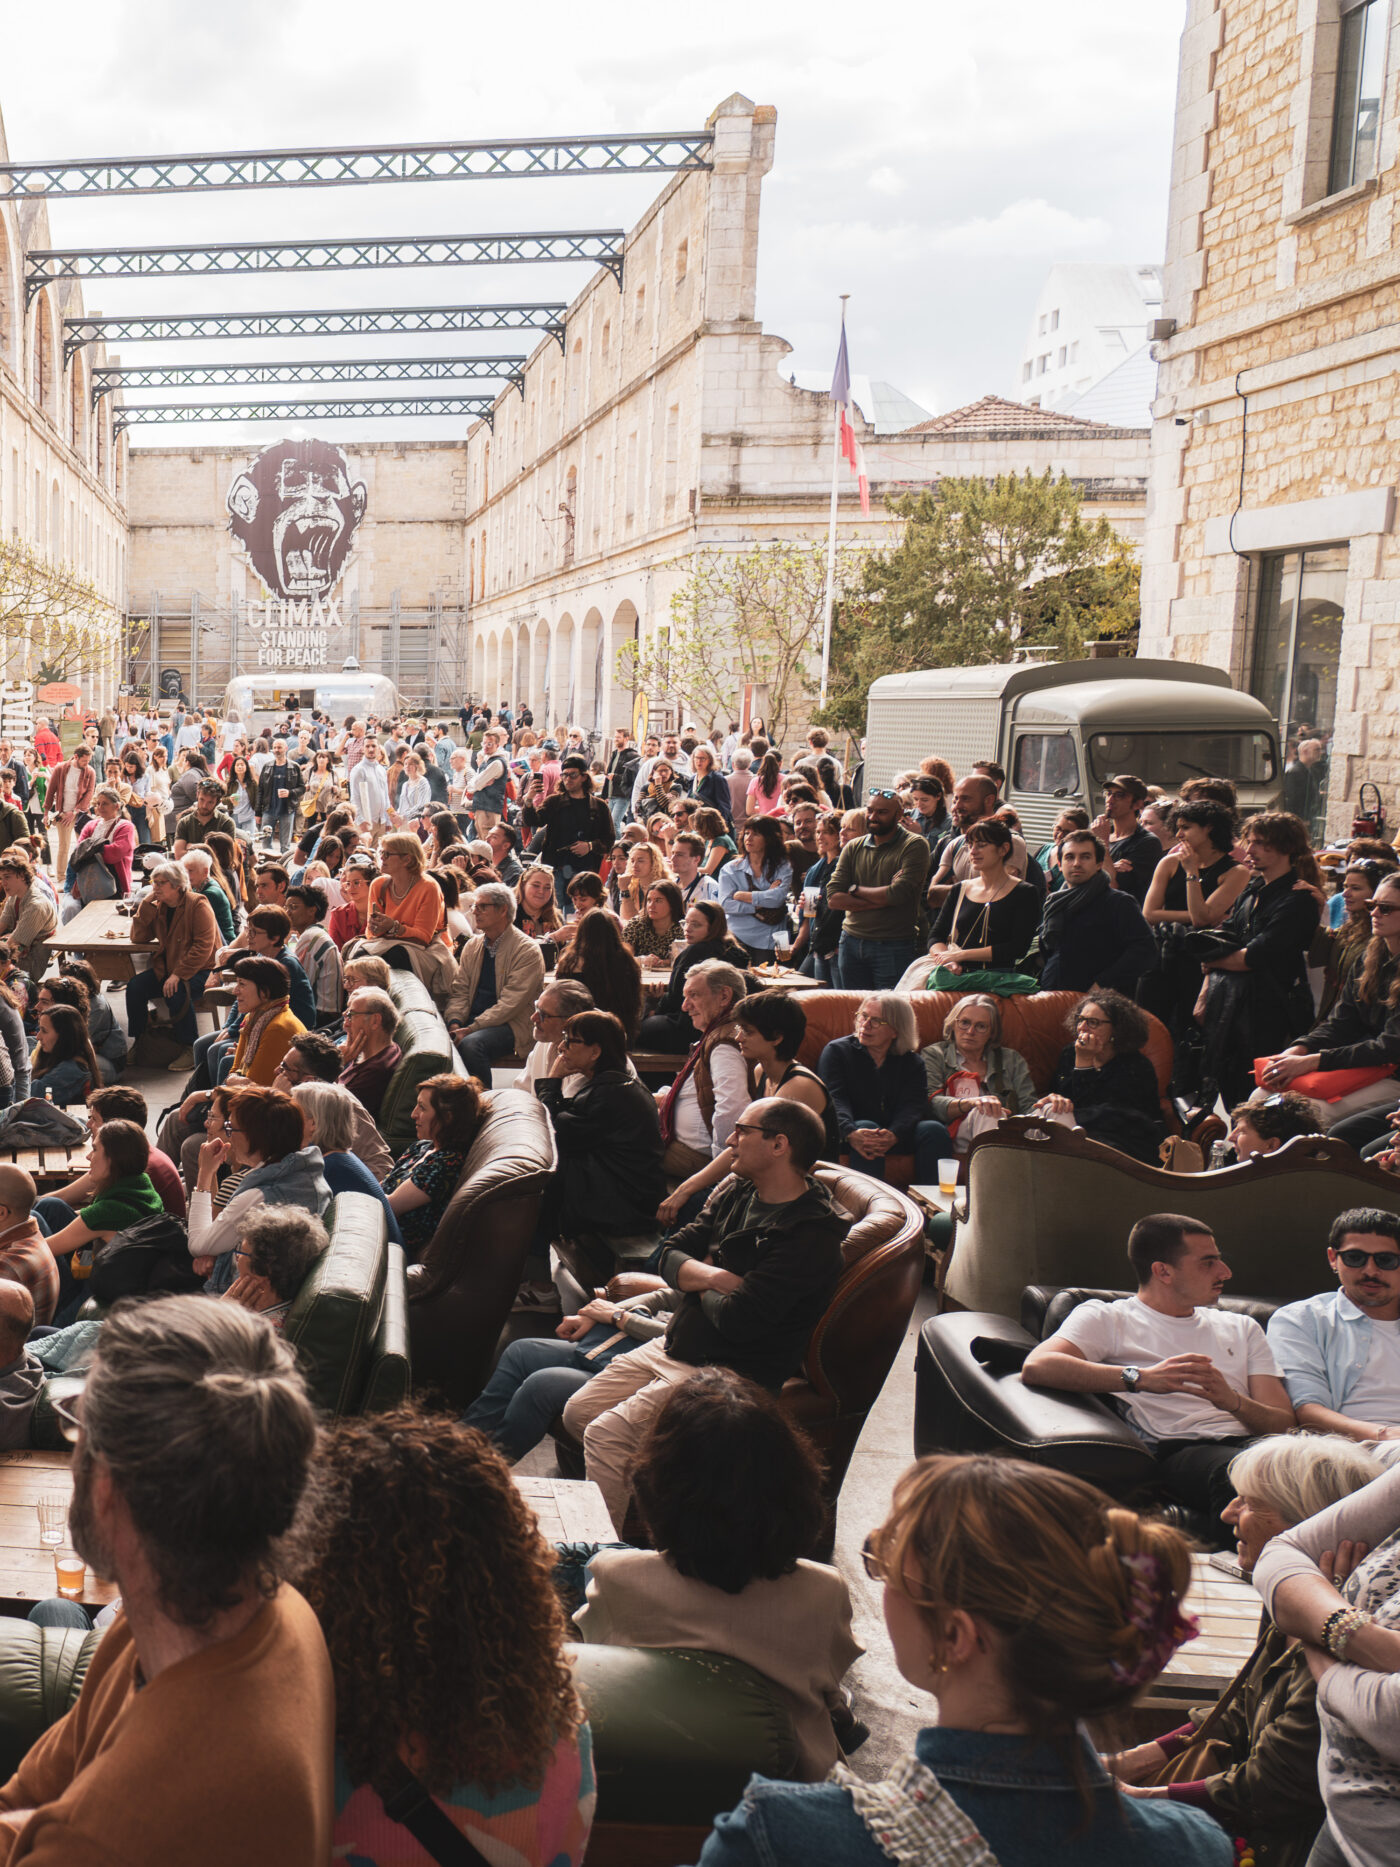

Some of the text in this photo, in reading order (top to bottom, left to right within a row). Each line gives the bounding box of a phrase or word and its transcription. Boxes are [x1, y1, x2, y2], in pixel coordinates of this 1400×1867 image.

[247, 598, 344, 628] CLIMAX
[261, 630, 328, 648] STANDING
[258, 648, 328, 666] FOR PEACE
